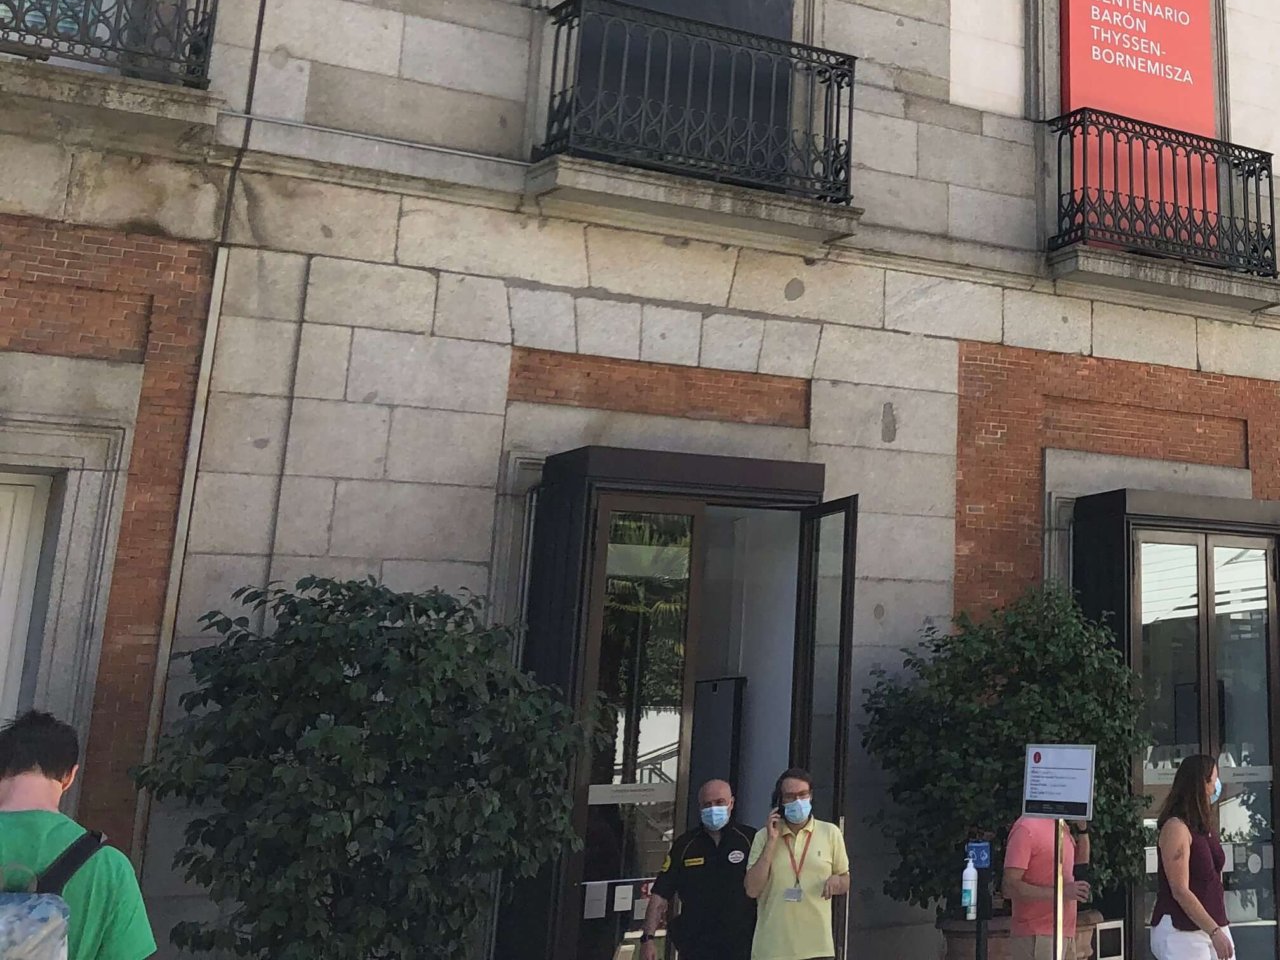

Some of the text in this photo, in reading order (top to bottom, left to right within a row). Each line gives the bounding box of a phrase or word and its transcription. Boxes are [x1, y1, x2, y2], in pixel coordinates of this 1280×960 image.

[1091, 6, 1147, 33] BARÓN
[1091, 25, 1166, 57] THYSSEN-
[1091, 46, 1193, 84] BORNEMISZA
